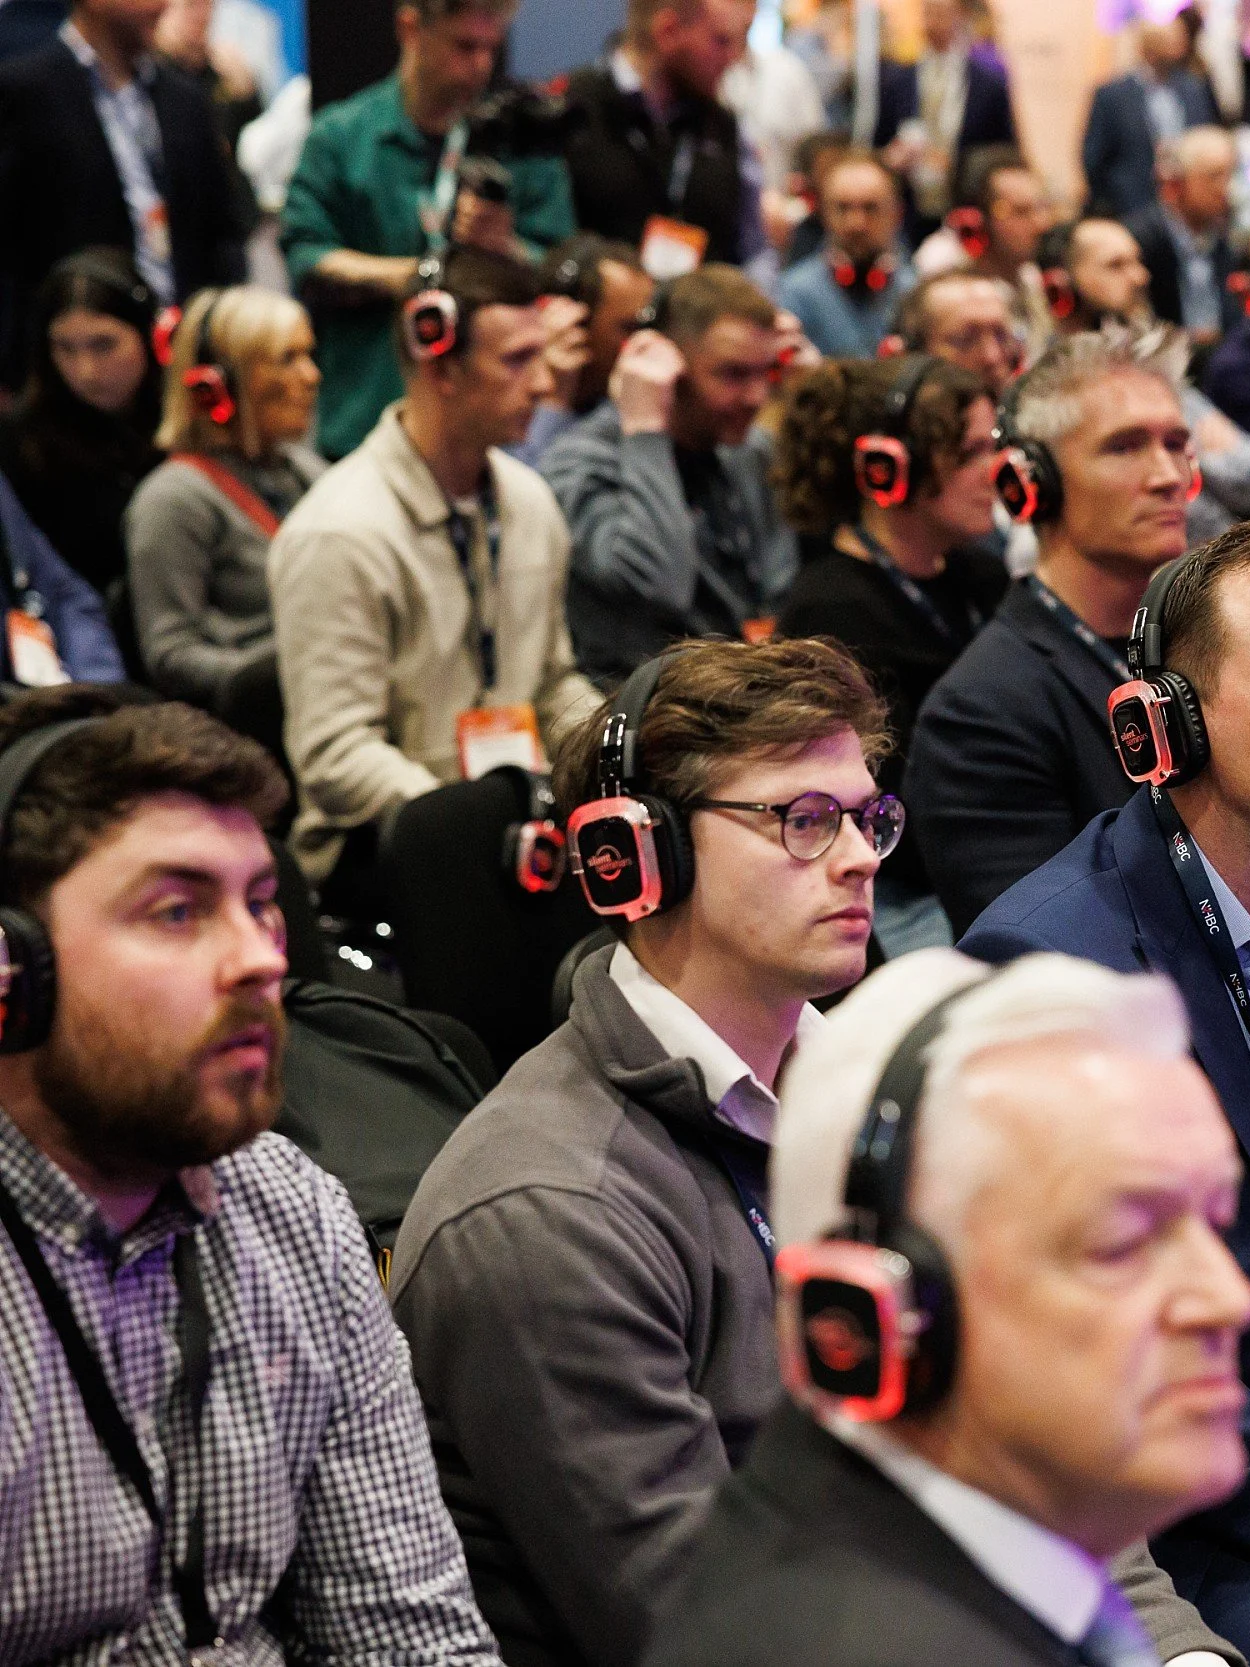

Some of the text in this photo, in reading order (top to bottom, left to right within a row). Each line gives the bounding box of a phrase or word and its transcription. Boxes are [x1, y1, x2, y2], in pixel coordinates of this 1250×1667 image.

[1172, 831, 1191, 862] NHBC
[1198, 898, 1220, 935] NHBC
[1229, 973, 1248, 1007] NHBC
[748, 1207, 776, 1247] NHBC
